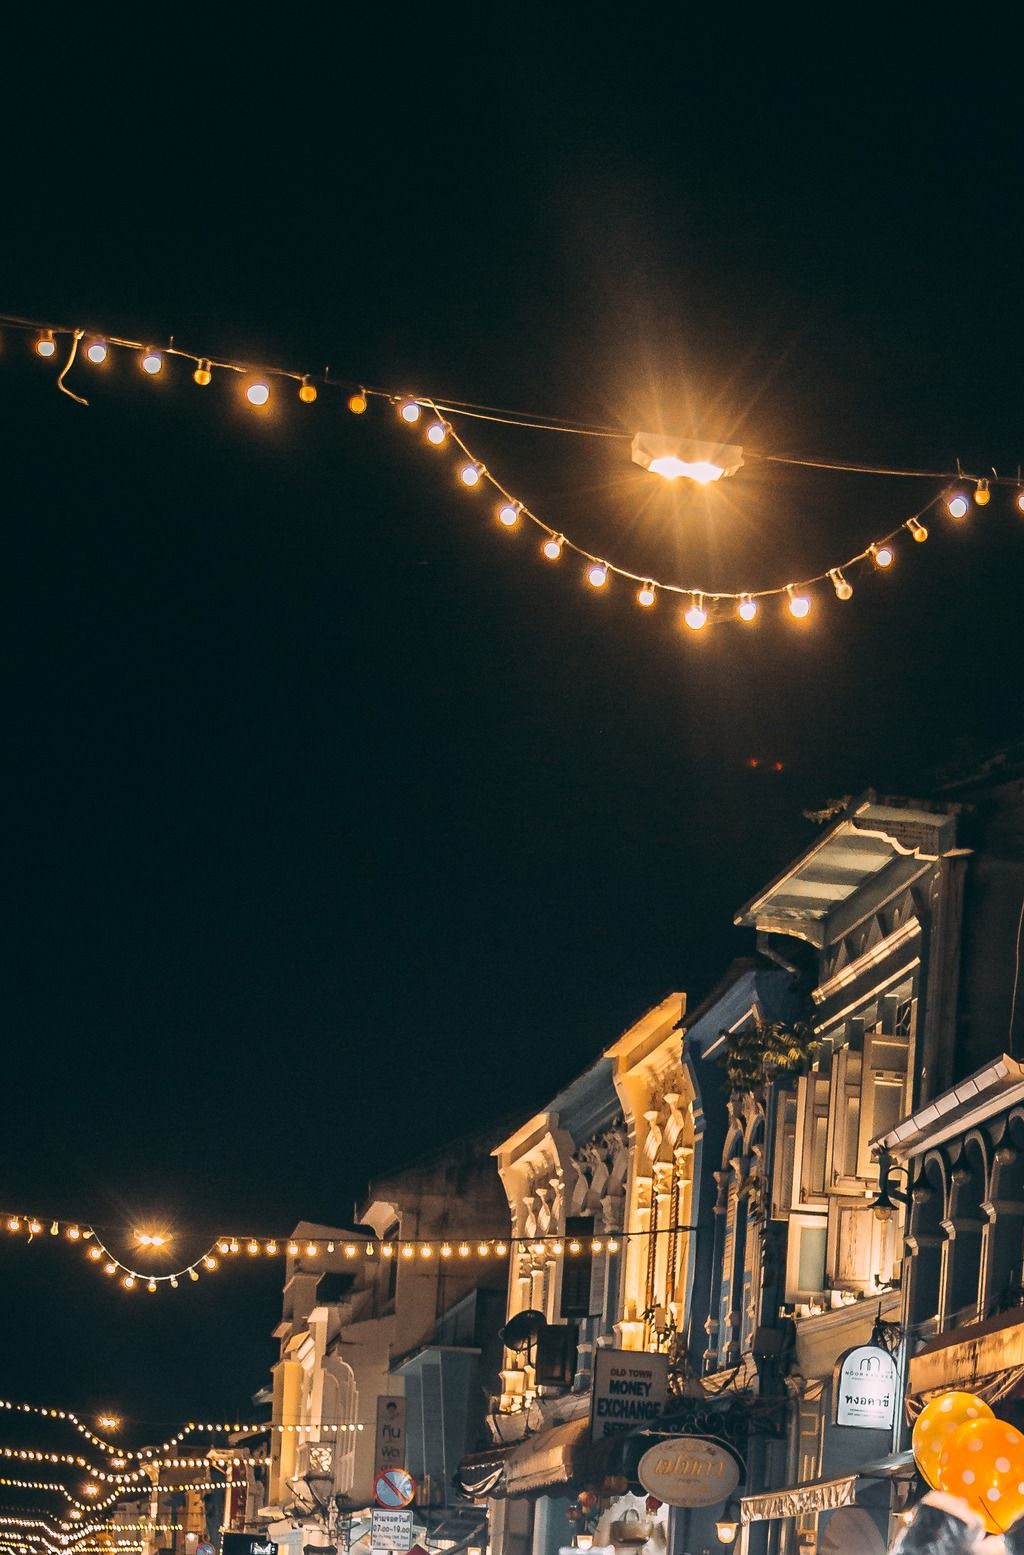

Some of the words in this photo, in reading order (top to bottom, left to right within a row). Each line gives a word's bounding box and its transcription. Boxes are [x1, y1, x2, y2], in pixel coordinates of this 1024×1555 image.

[610, 1368, 626, 1377] OLD
[629, 1369, 653, 1379] TOWN
[609, 1380, 652, 1397] MONEY
